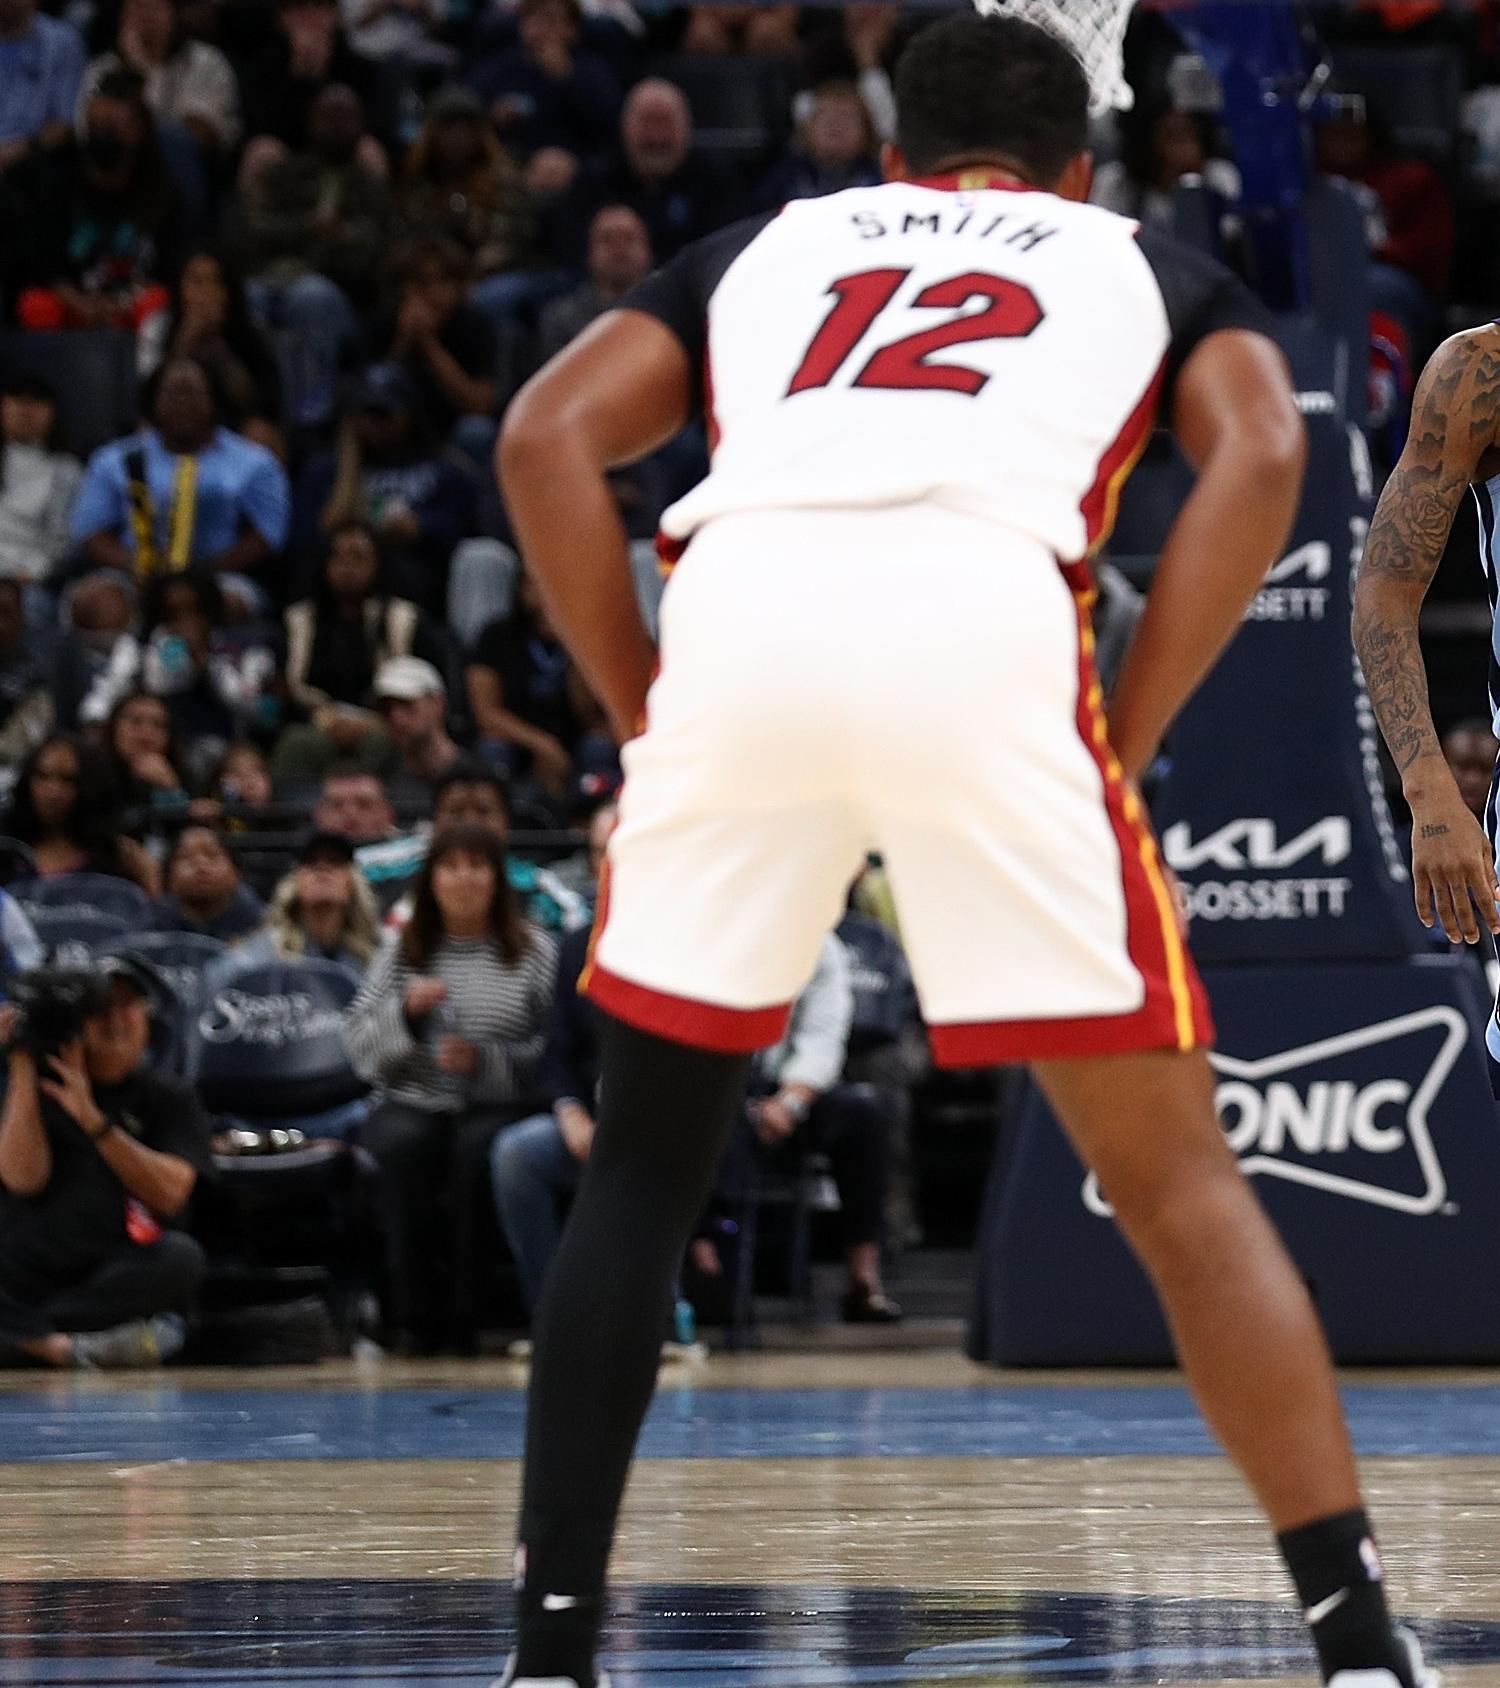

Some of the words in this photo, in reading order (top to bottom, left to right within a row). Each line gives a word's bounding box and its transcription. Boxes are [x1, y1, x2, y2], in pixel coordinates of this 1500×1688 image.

[851, 210, 1060, 252] SMITH
[783, 265, 1045, 398] 12
[1162, 815, 1351, 871] KIA
[1213, 1078, 1412, 1153] ONIC
